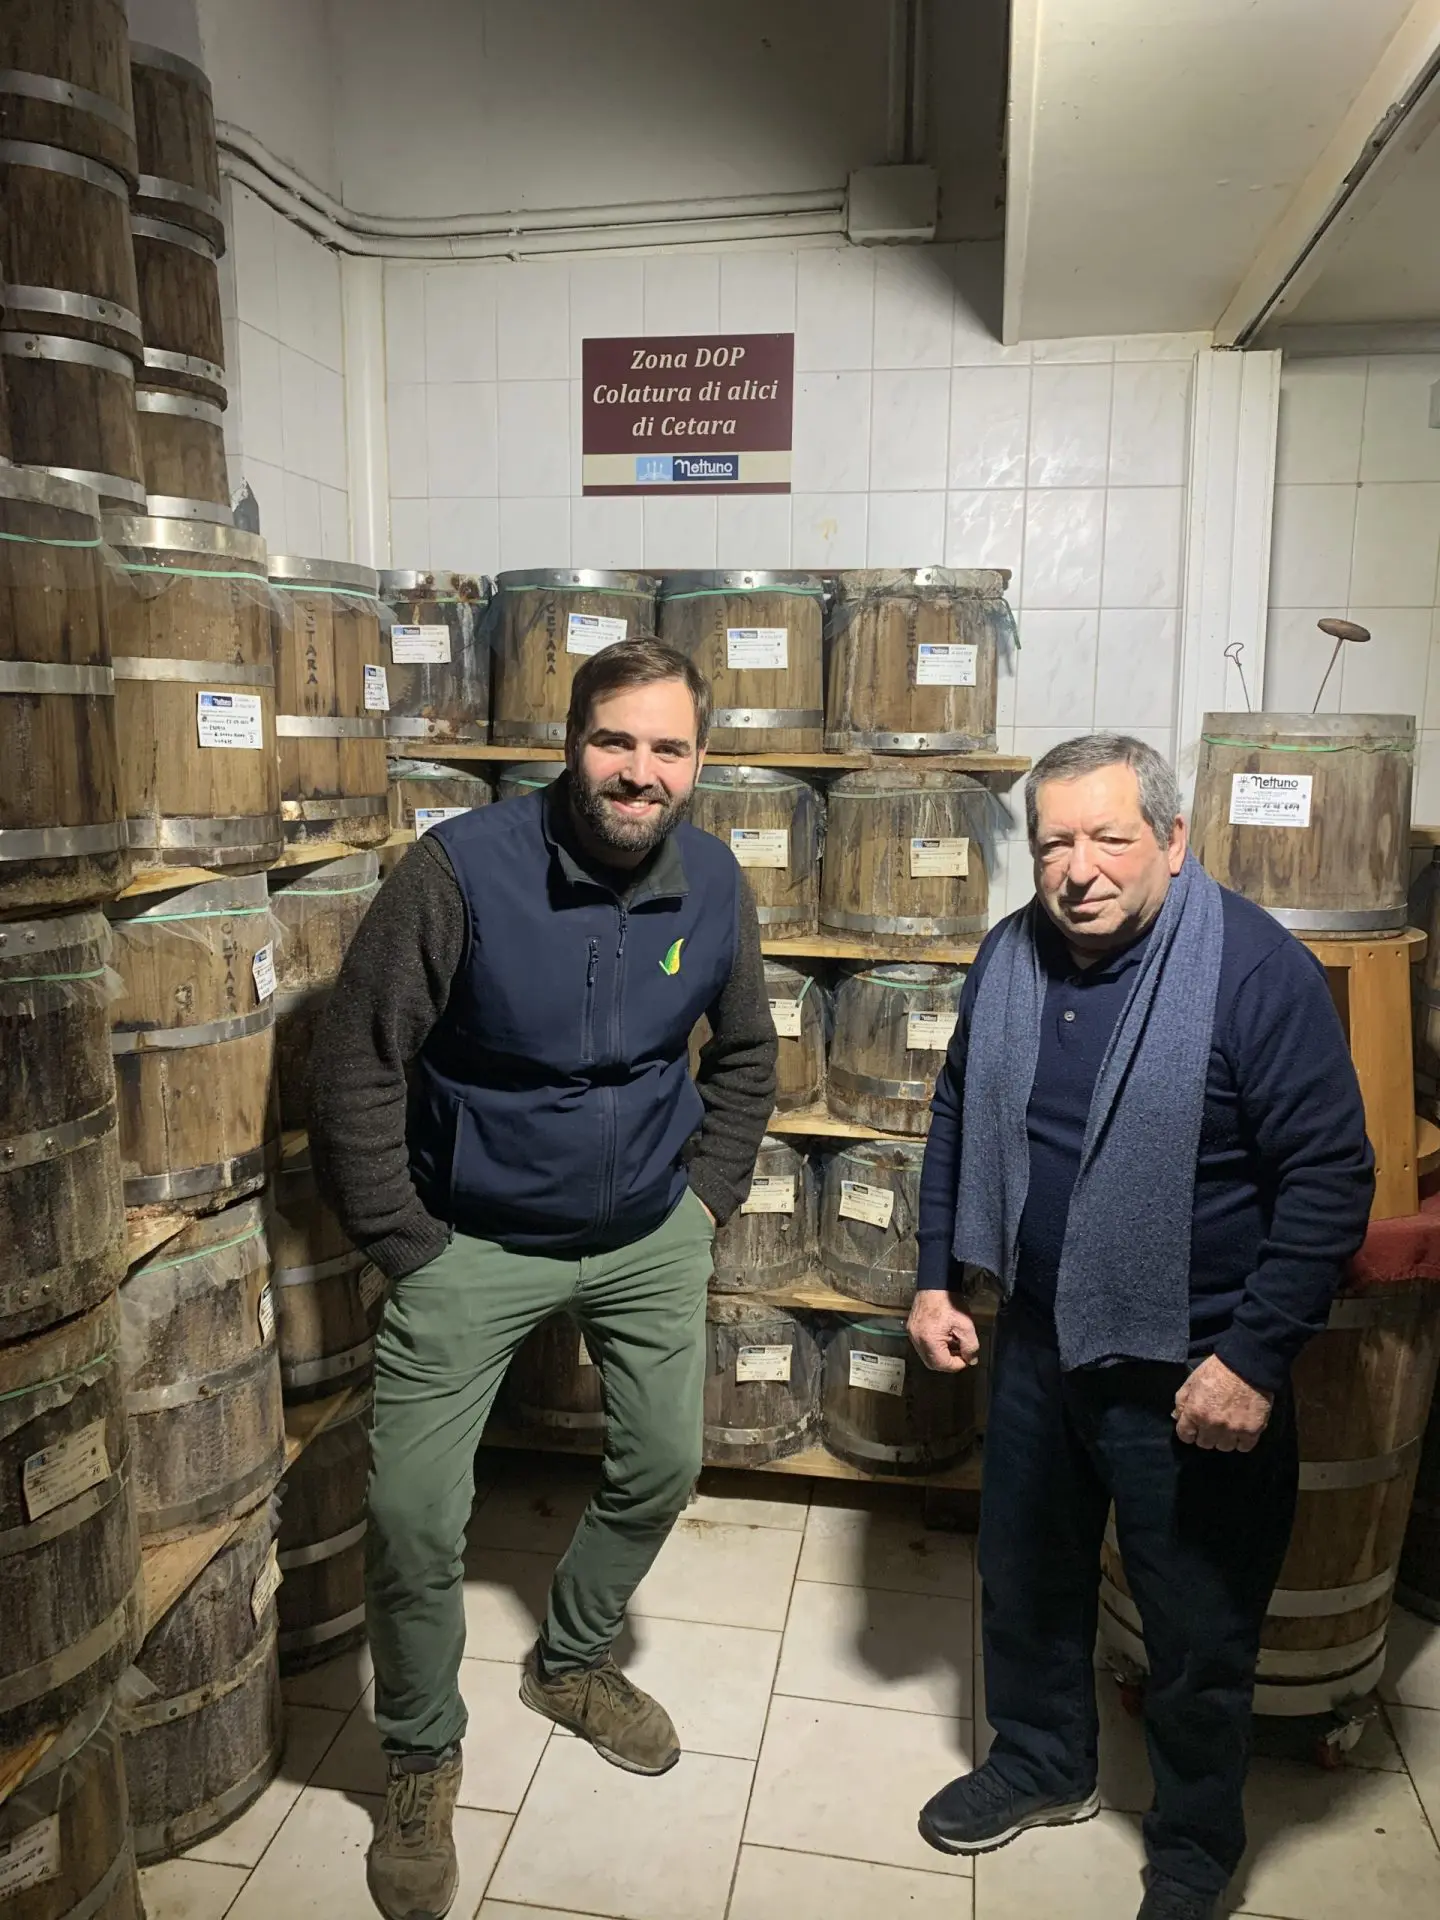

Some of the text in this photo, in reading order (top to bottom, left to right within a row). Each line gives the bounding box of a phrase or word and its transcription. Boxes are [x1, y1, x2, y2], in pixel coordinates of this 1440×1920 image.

[630, 347, 745, 370] Zona DOP
[593, 380, 778, 404] Colatura di alici
[632, 416, 737, 437] di Cetara
[546, 603, 557, 675] CETARA
[713, 608, 724, 681] CETARA
